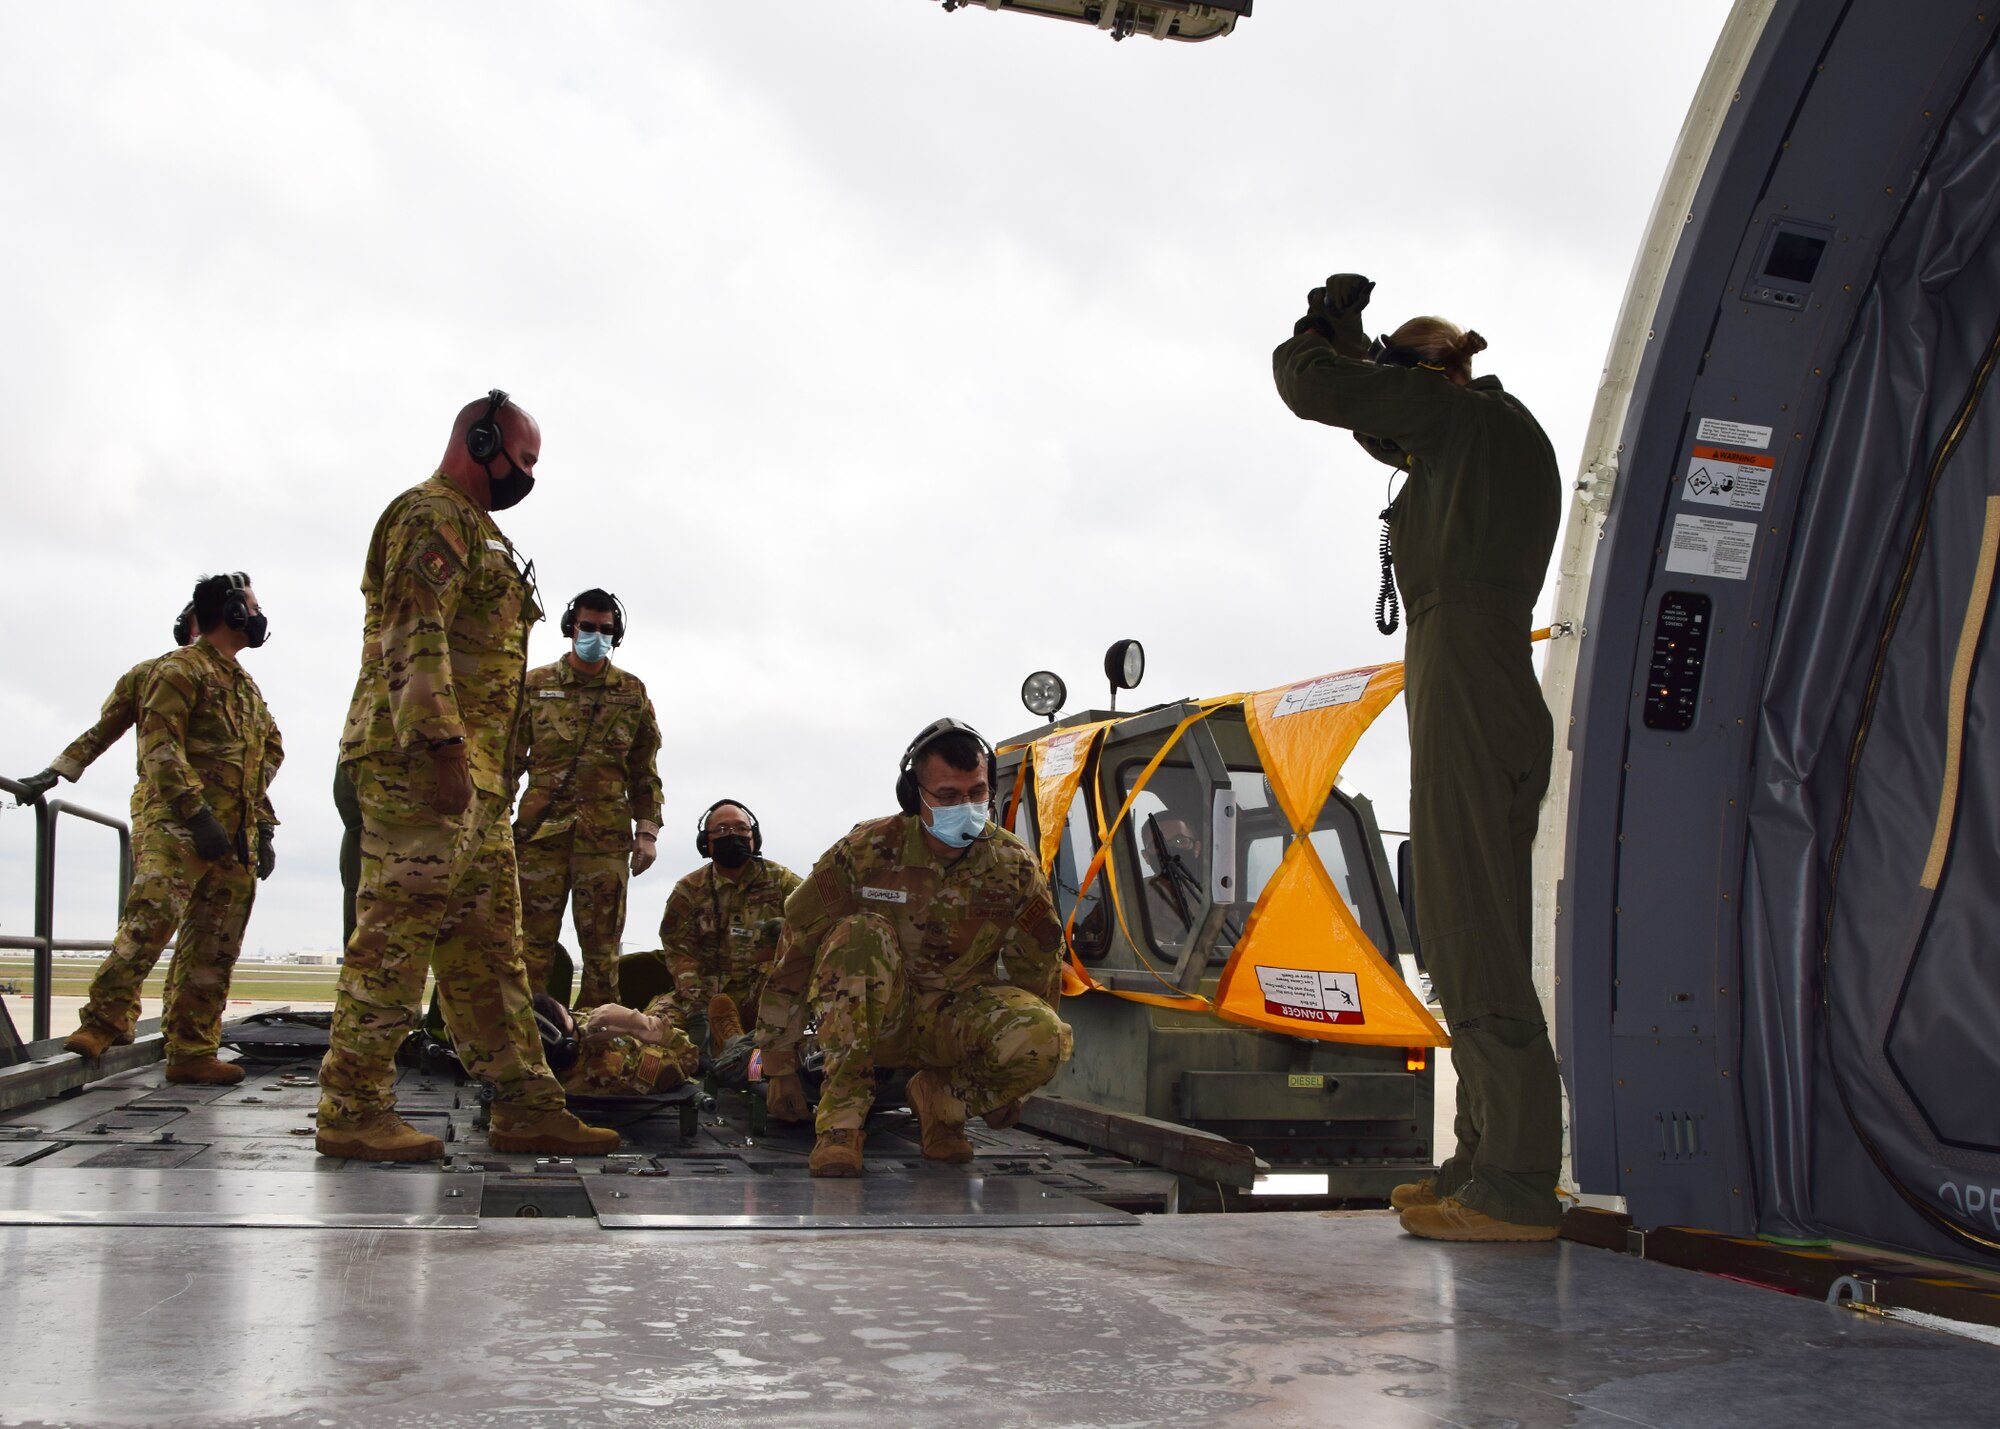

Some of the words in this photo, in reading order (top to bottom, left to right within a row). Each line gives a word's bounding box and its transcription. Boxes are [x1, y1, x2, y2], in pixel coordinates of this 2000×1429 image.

[1720, 452, 1756, 463] WARNING
[1019, 900, 1046, 930] MED
[1282, 1006, 1324, 1020] DANGER
[1291, 1076, 1322, 1086] DIESEL
